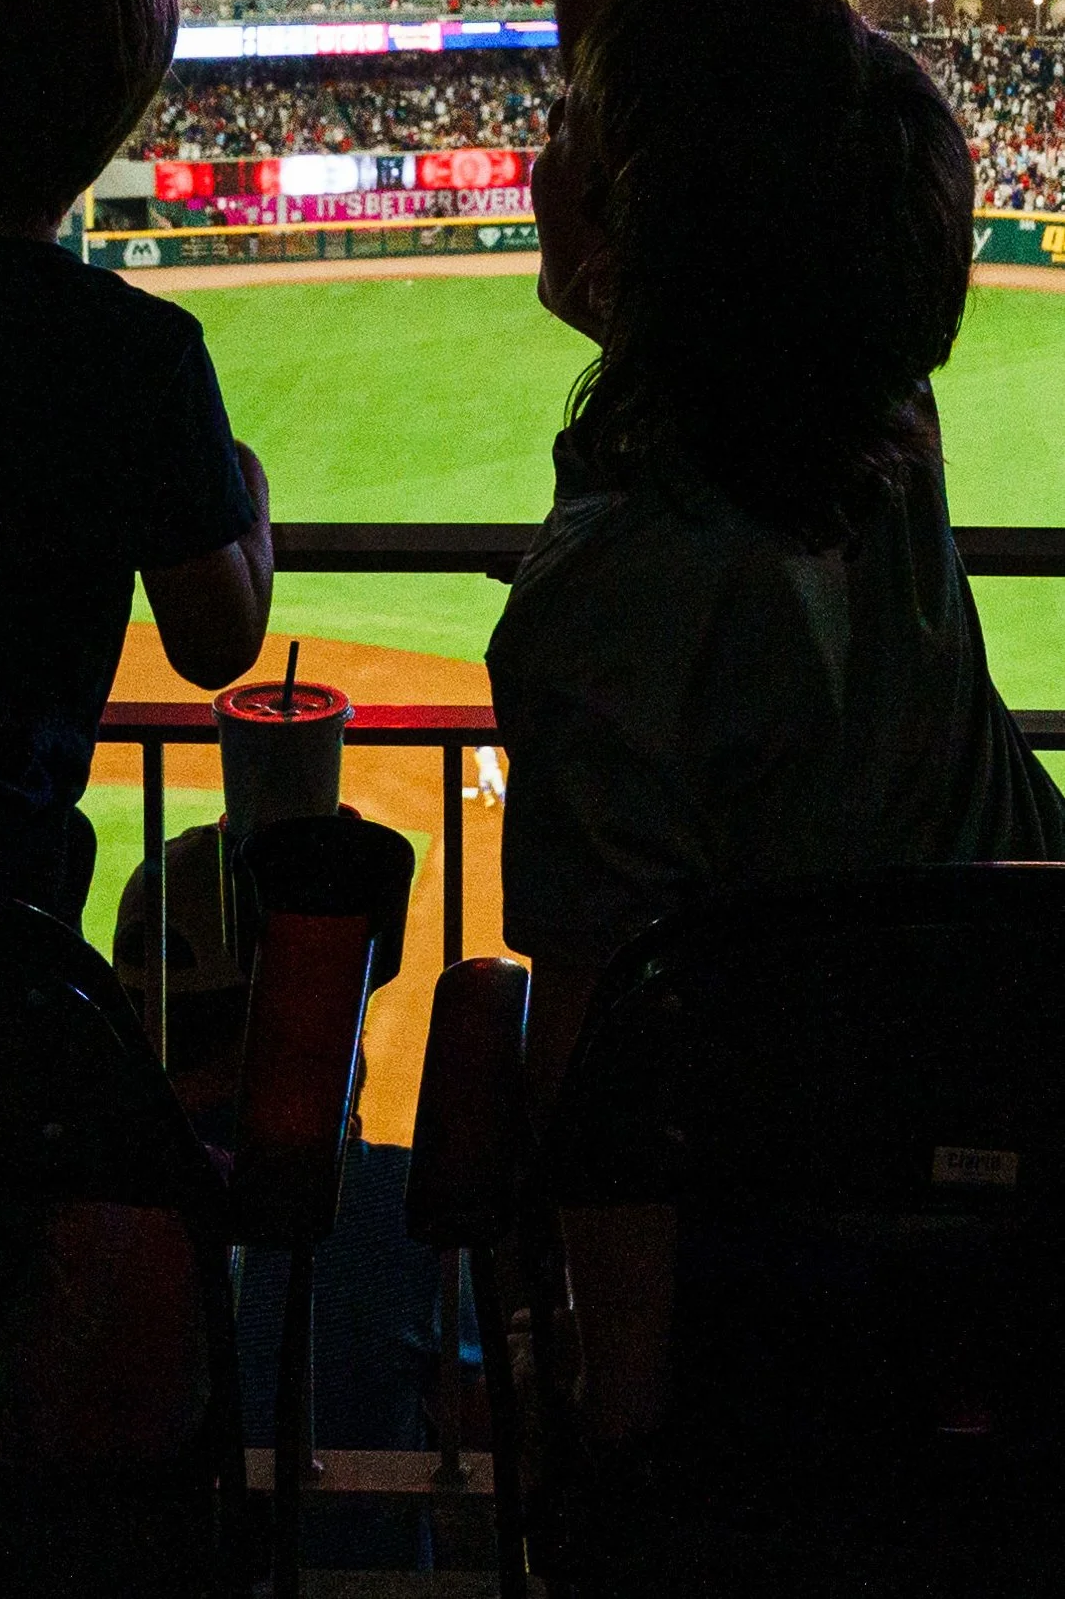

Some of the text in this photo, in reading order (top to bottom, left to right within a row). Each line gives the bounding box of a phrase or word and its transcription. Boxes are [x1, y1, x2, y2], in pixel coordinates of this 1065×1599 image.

[317, 193, 363, 218] IT'S
[364, 189, 453, 215] BETTER
[456, 187, 521, 211] OVER
